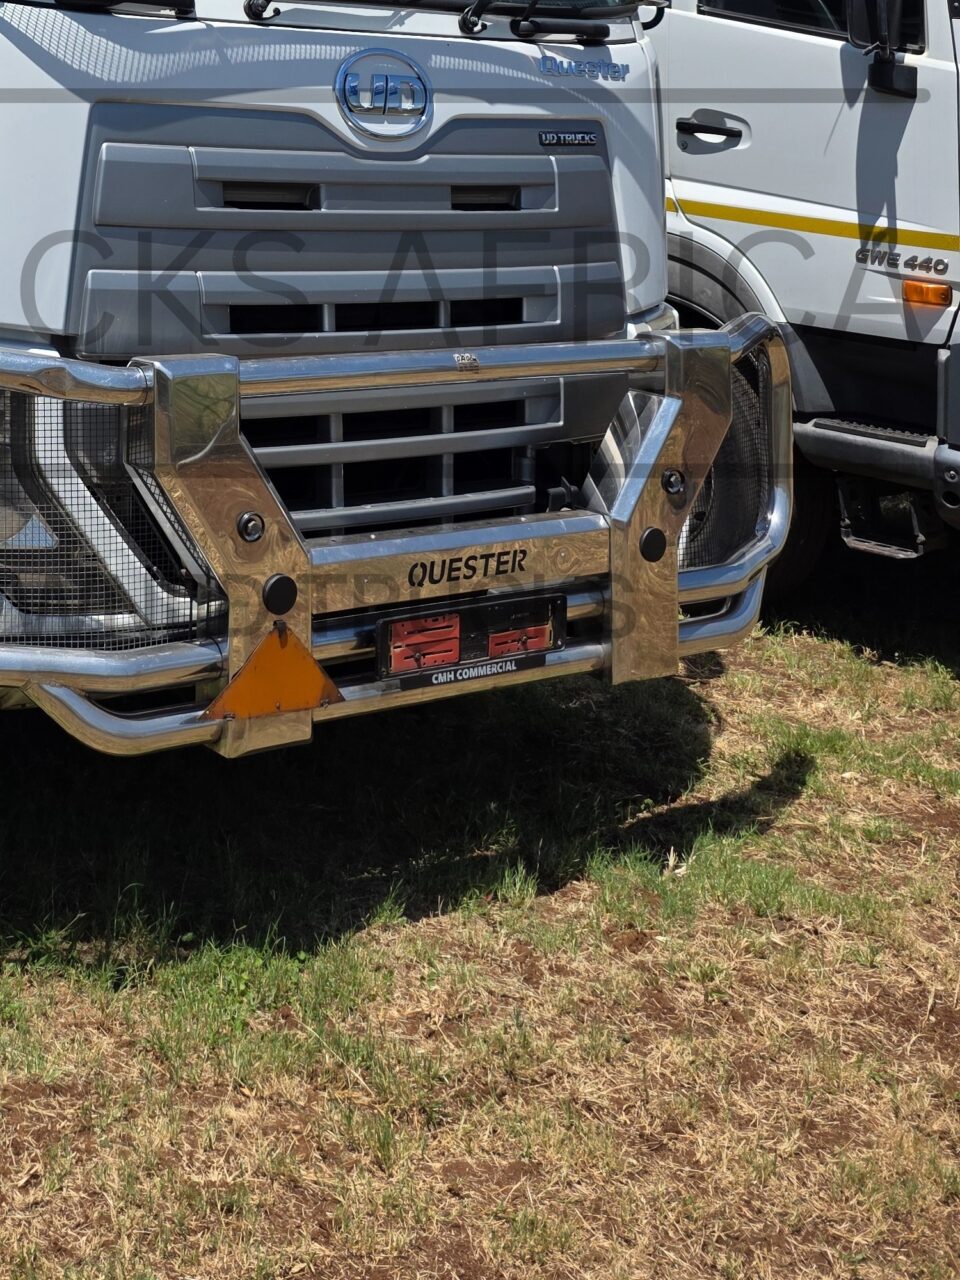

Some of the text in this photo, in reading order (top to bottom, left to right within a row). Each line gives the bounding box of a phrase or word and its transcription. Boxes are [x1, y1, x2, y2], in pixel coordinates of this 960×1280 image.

[540, 55, 630, 81] Quester
[344, 73, 428, 116] UD
[541, 132, 597, 145] UD TRUCKS
[855, 247, 949, 275] GWE 440
[408, 549, 528, 588] QUESTER
[432, 660, 517, 684] CMH COMMERCIAL
